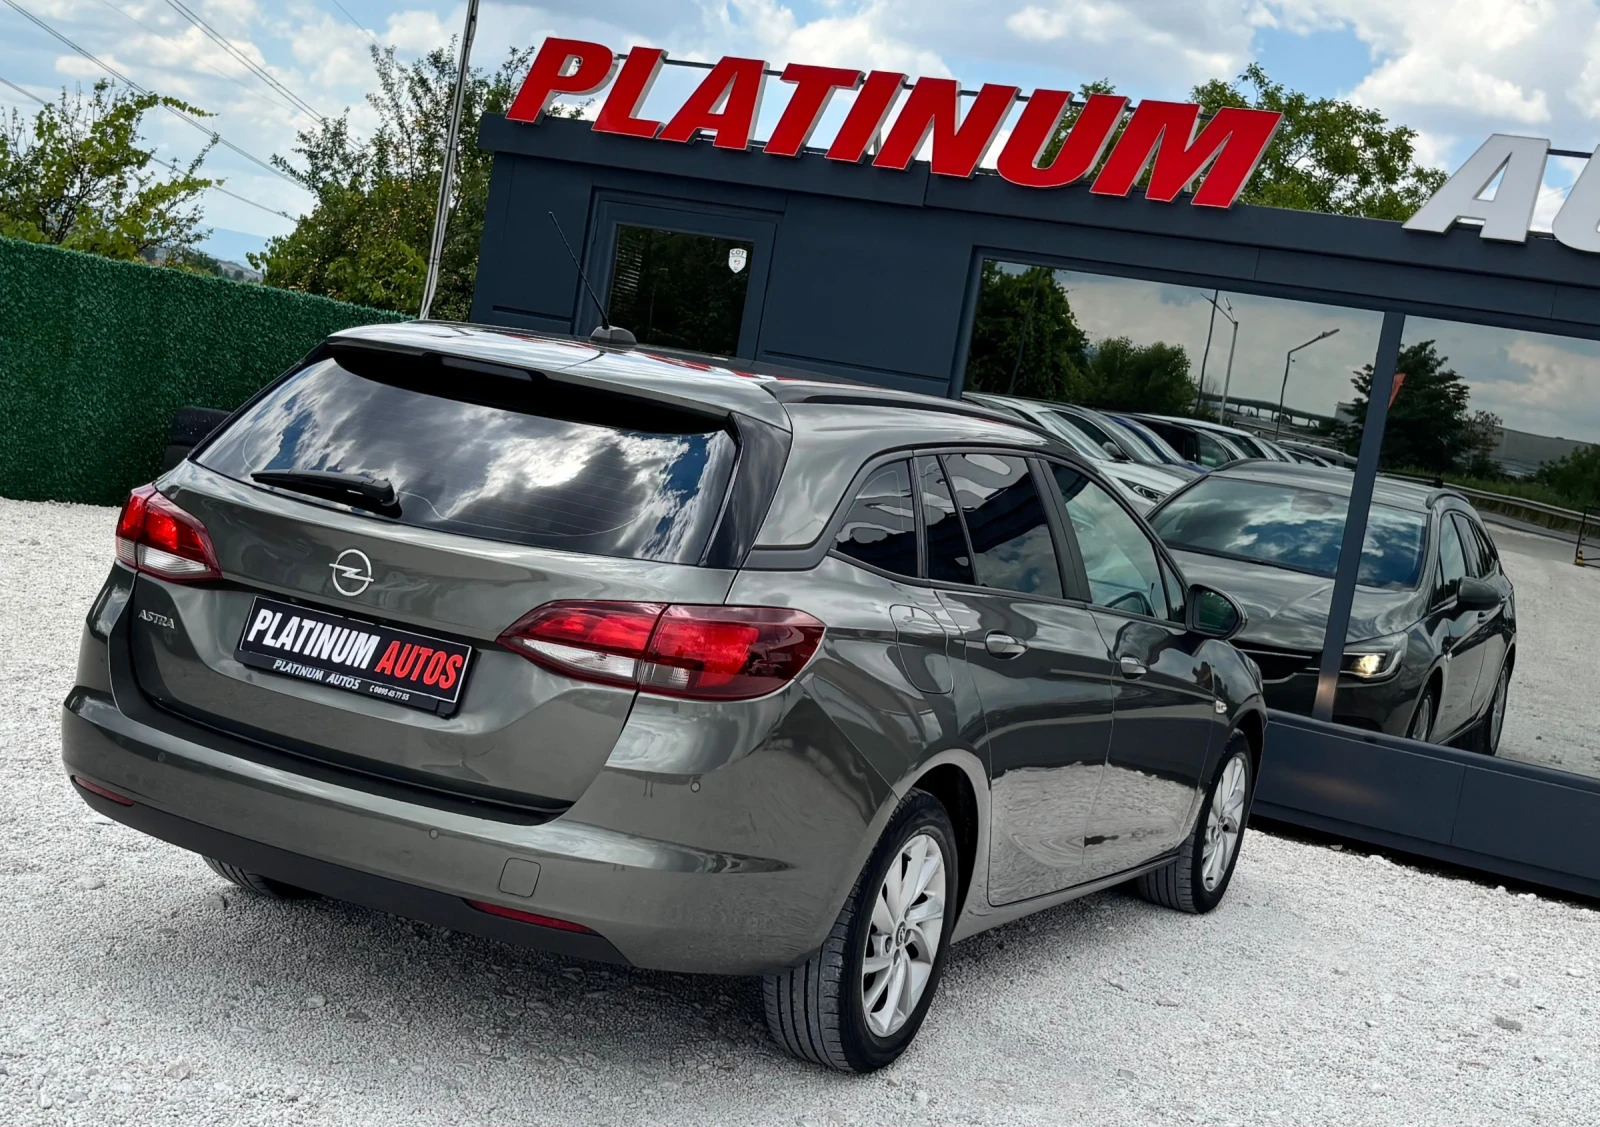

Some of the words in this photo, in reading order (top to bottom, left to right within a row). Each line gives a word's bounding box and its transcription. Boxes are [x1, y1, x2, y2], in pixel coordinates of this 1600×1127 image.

[504, 36, 1284, 209] PLATINUM
[138, 609, 175, 629] ASTRA
[247, 608, 381, 669] PLATINUM
[375, 640, 464, 690] AUTOS
[272, 659, 325, 681] PLATINUM
[326, 673, 361, 690] AUTOS
